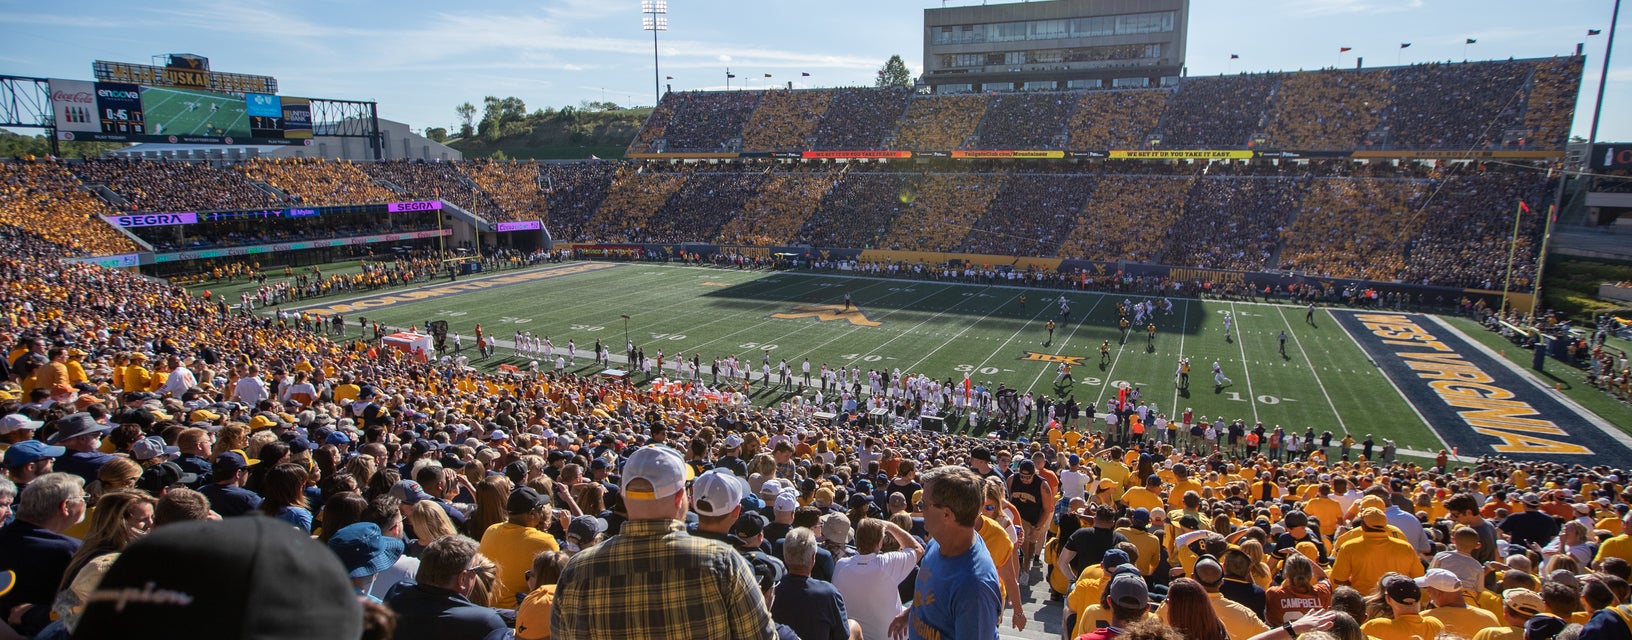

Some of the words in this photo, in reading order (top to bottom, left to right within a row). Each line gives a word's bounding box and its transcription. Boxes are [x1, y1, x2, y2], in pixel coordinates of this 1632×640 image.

[112, 65, 156, 82] MILAN
[161, 70, 211, 88] PUSKAR
[216, 75, 265, 91] STADIUM
[52, 90, 94, 104] Coca-Cola
[289, 109, 310, 118] UNITED
[396, 202, 433, 211] SEGRA
[119, 214, 182, 226] SEGRA
[1353, 314, 1454, 352] WEST
[739, 342, 778, 350] 50
[842, 354, 882, 362] 40
[954, 364, 999, 374] 30
[1081, 377, 1131, 388] 20
[1225, 392, 1280, 404] 10
[1394, 352, 1596, 455] VIRGINIA
[1280, 598, 1323, 608] CAMPBELL
